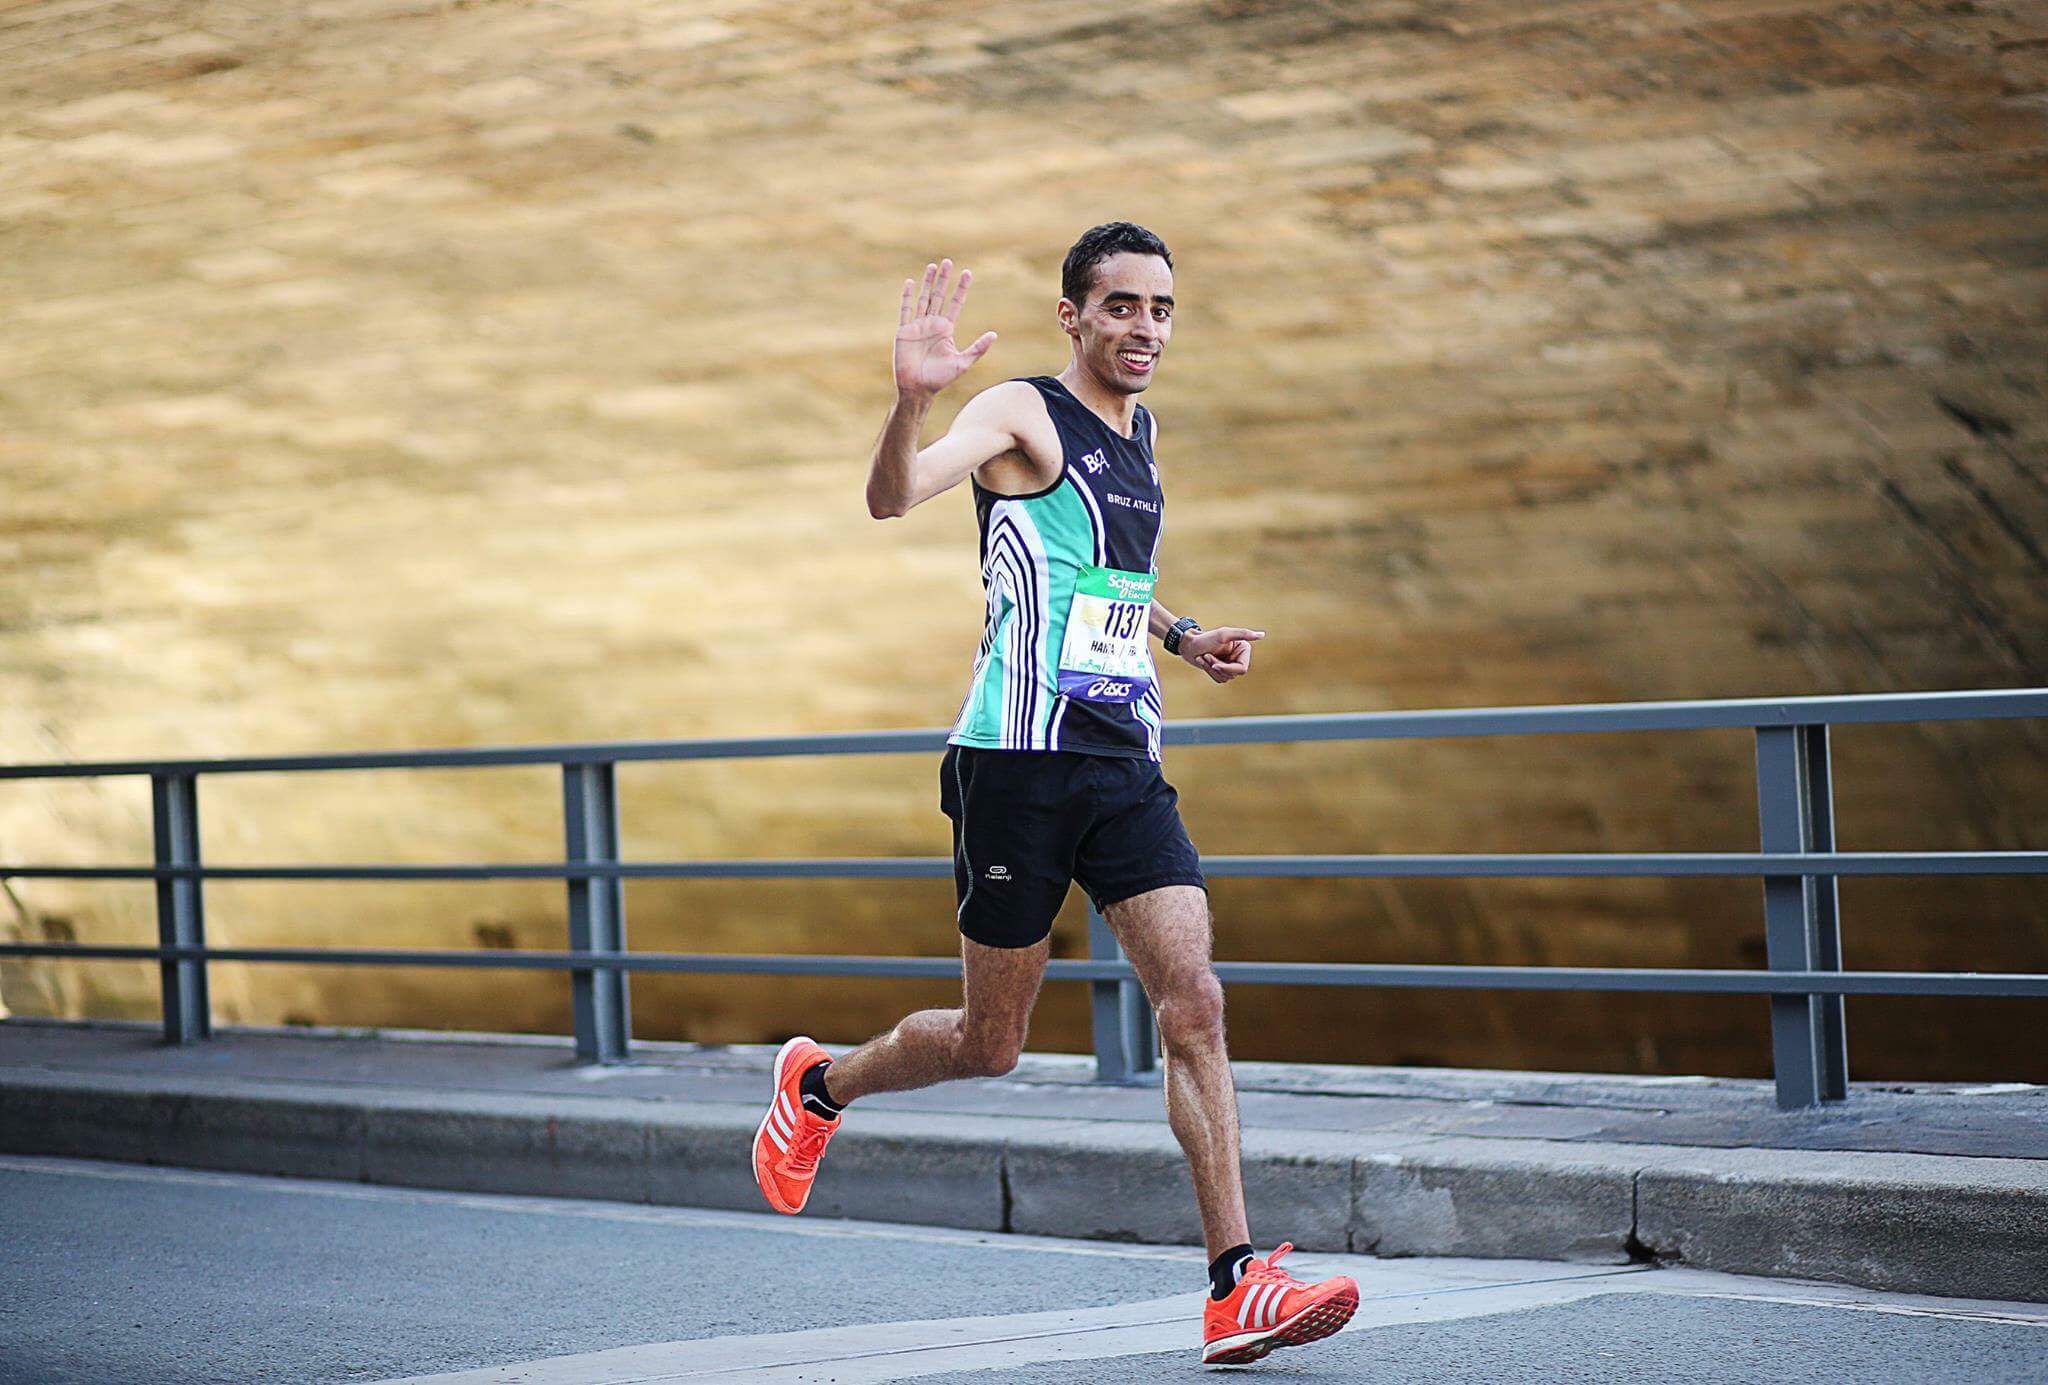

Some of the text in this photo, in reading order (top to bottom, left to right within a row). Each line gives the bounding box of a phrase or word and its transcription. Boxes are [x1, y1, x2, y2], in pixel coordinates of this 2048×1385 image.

[1106, 493, 1158, 514] BRUZ ATHLÉ
[1104, 602, 1145, 640] 1137
